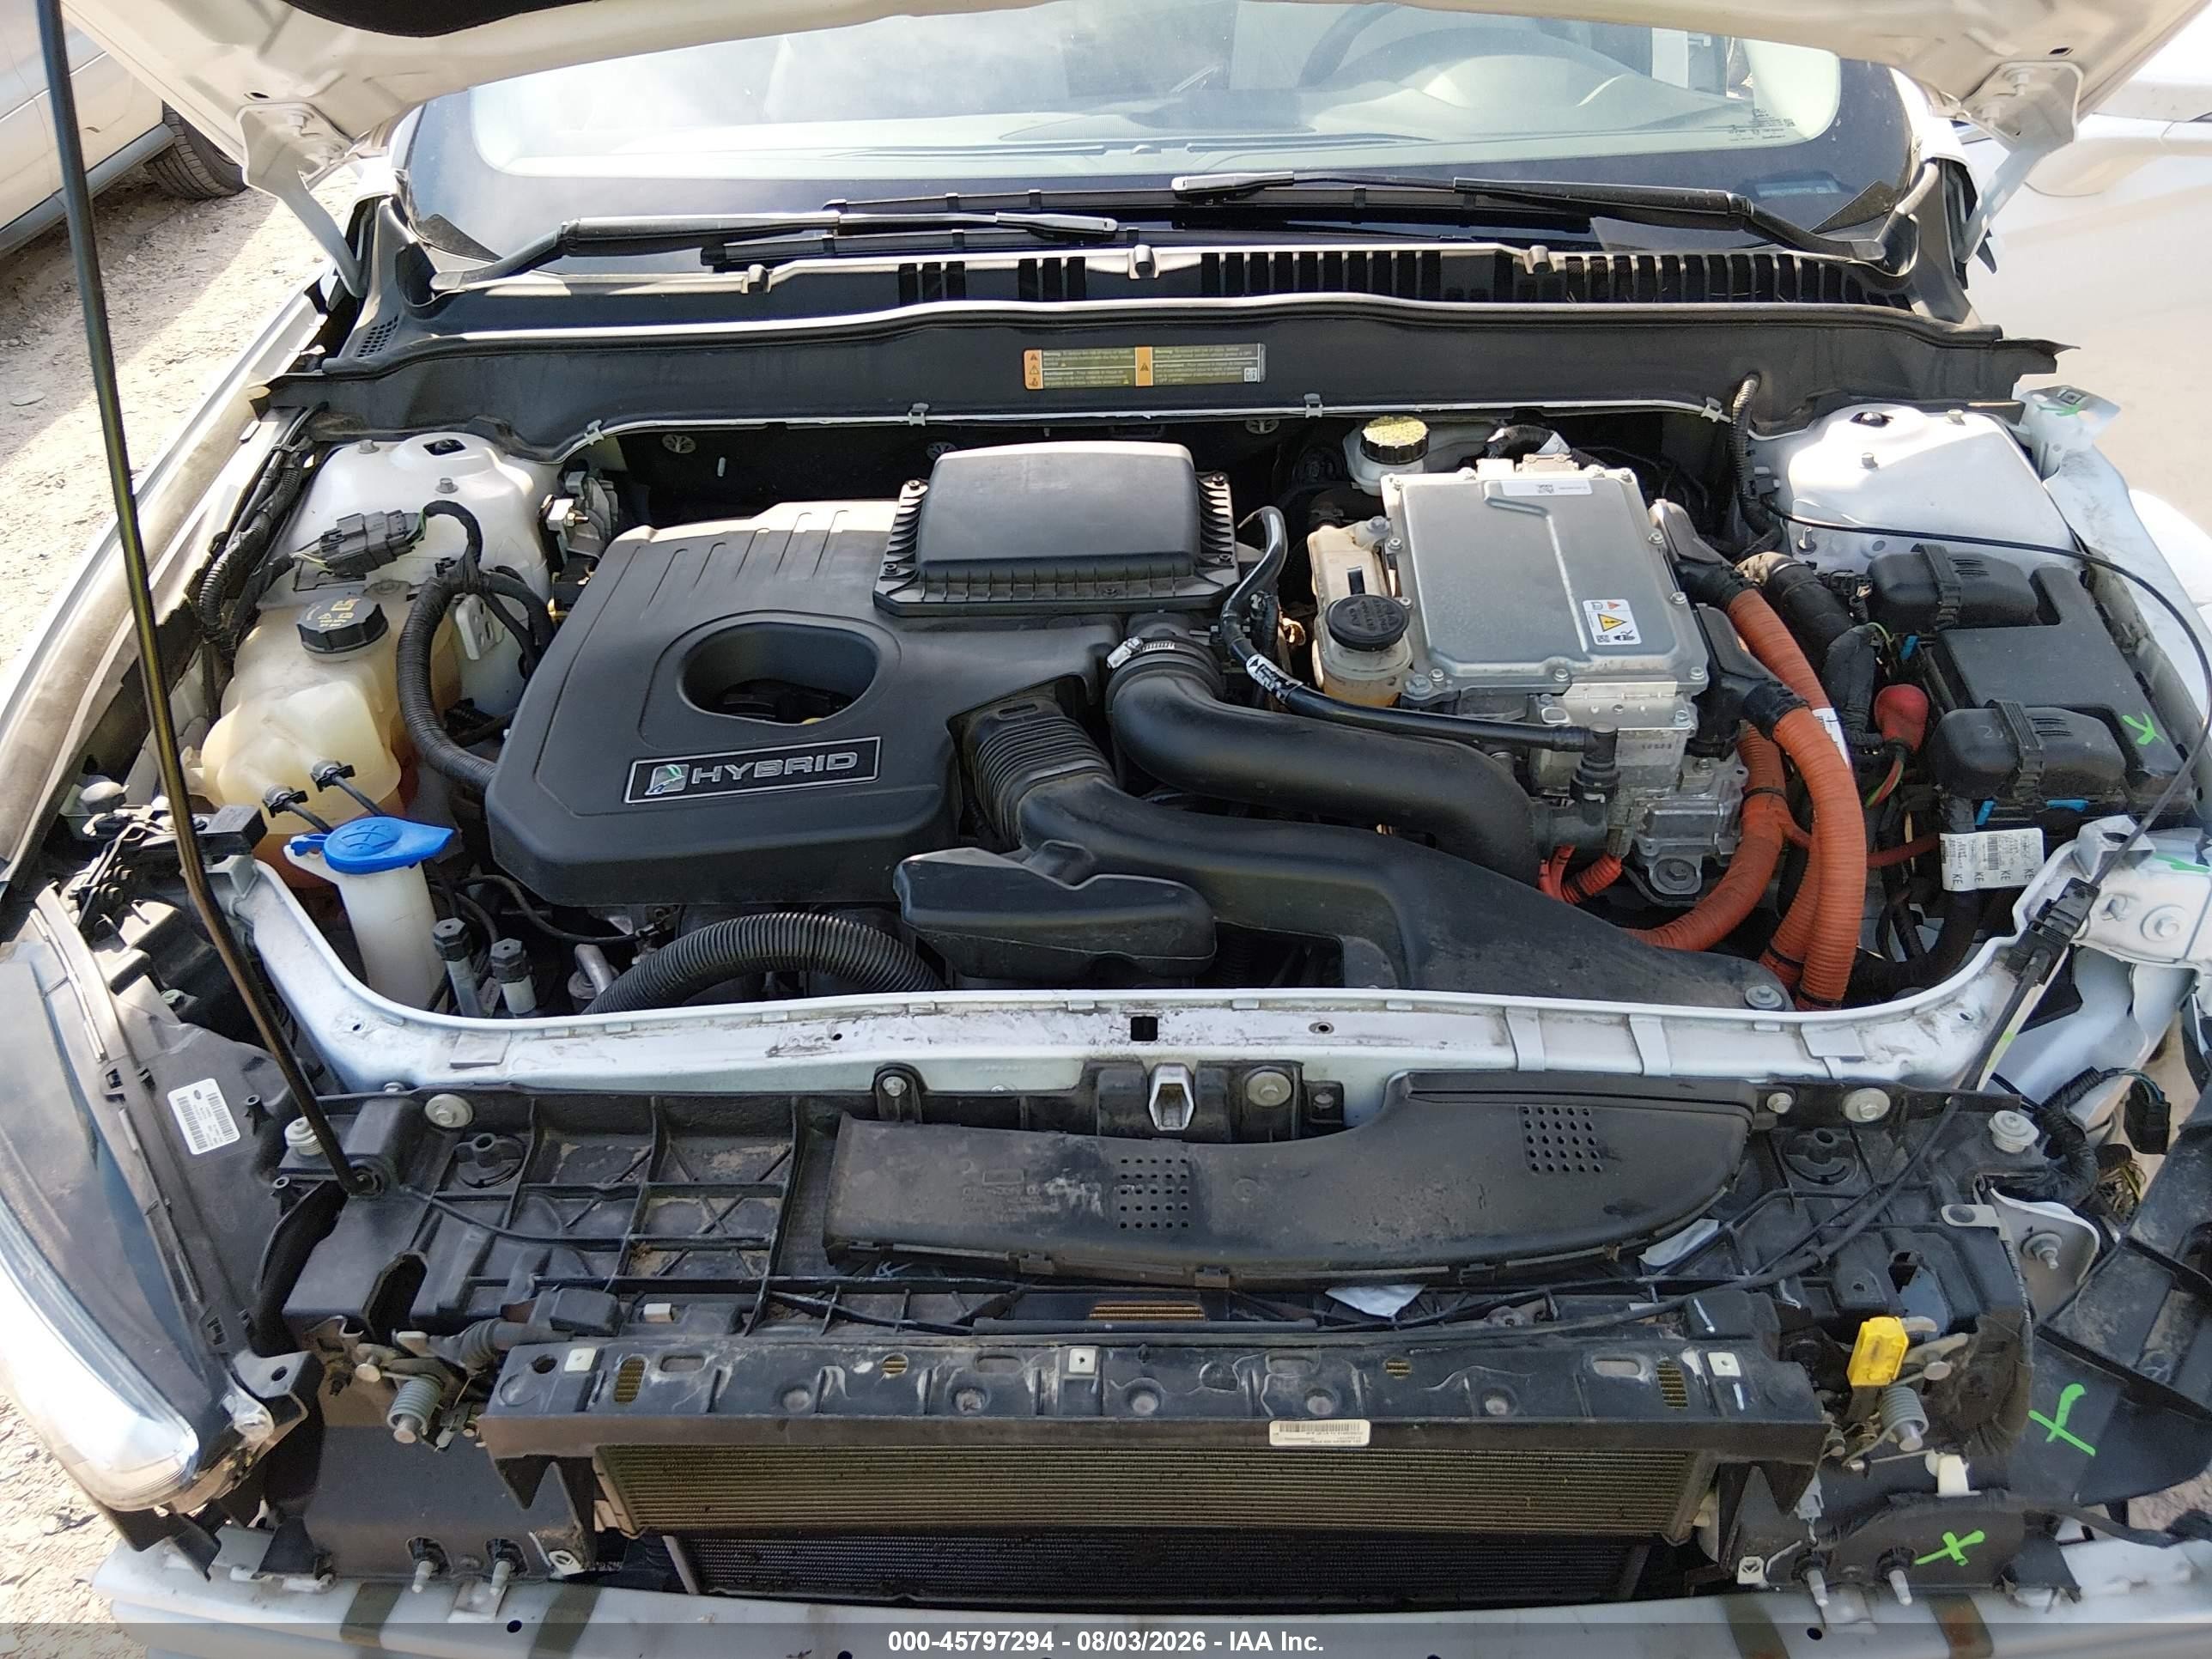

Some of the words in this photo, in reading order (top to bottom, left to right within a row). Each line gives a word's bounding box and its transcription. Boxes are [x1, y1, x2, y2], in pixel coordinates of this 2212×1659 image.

[690, 751, 858, 785] HYBRID
[1952, 873, 1963, 885] KE
[1974, 872, 1984, 883] KE
[2000, 870, 2011, 880] KE
[2024, 868, 2034, 879] KE
